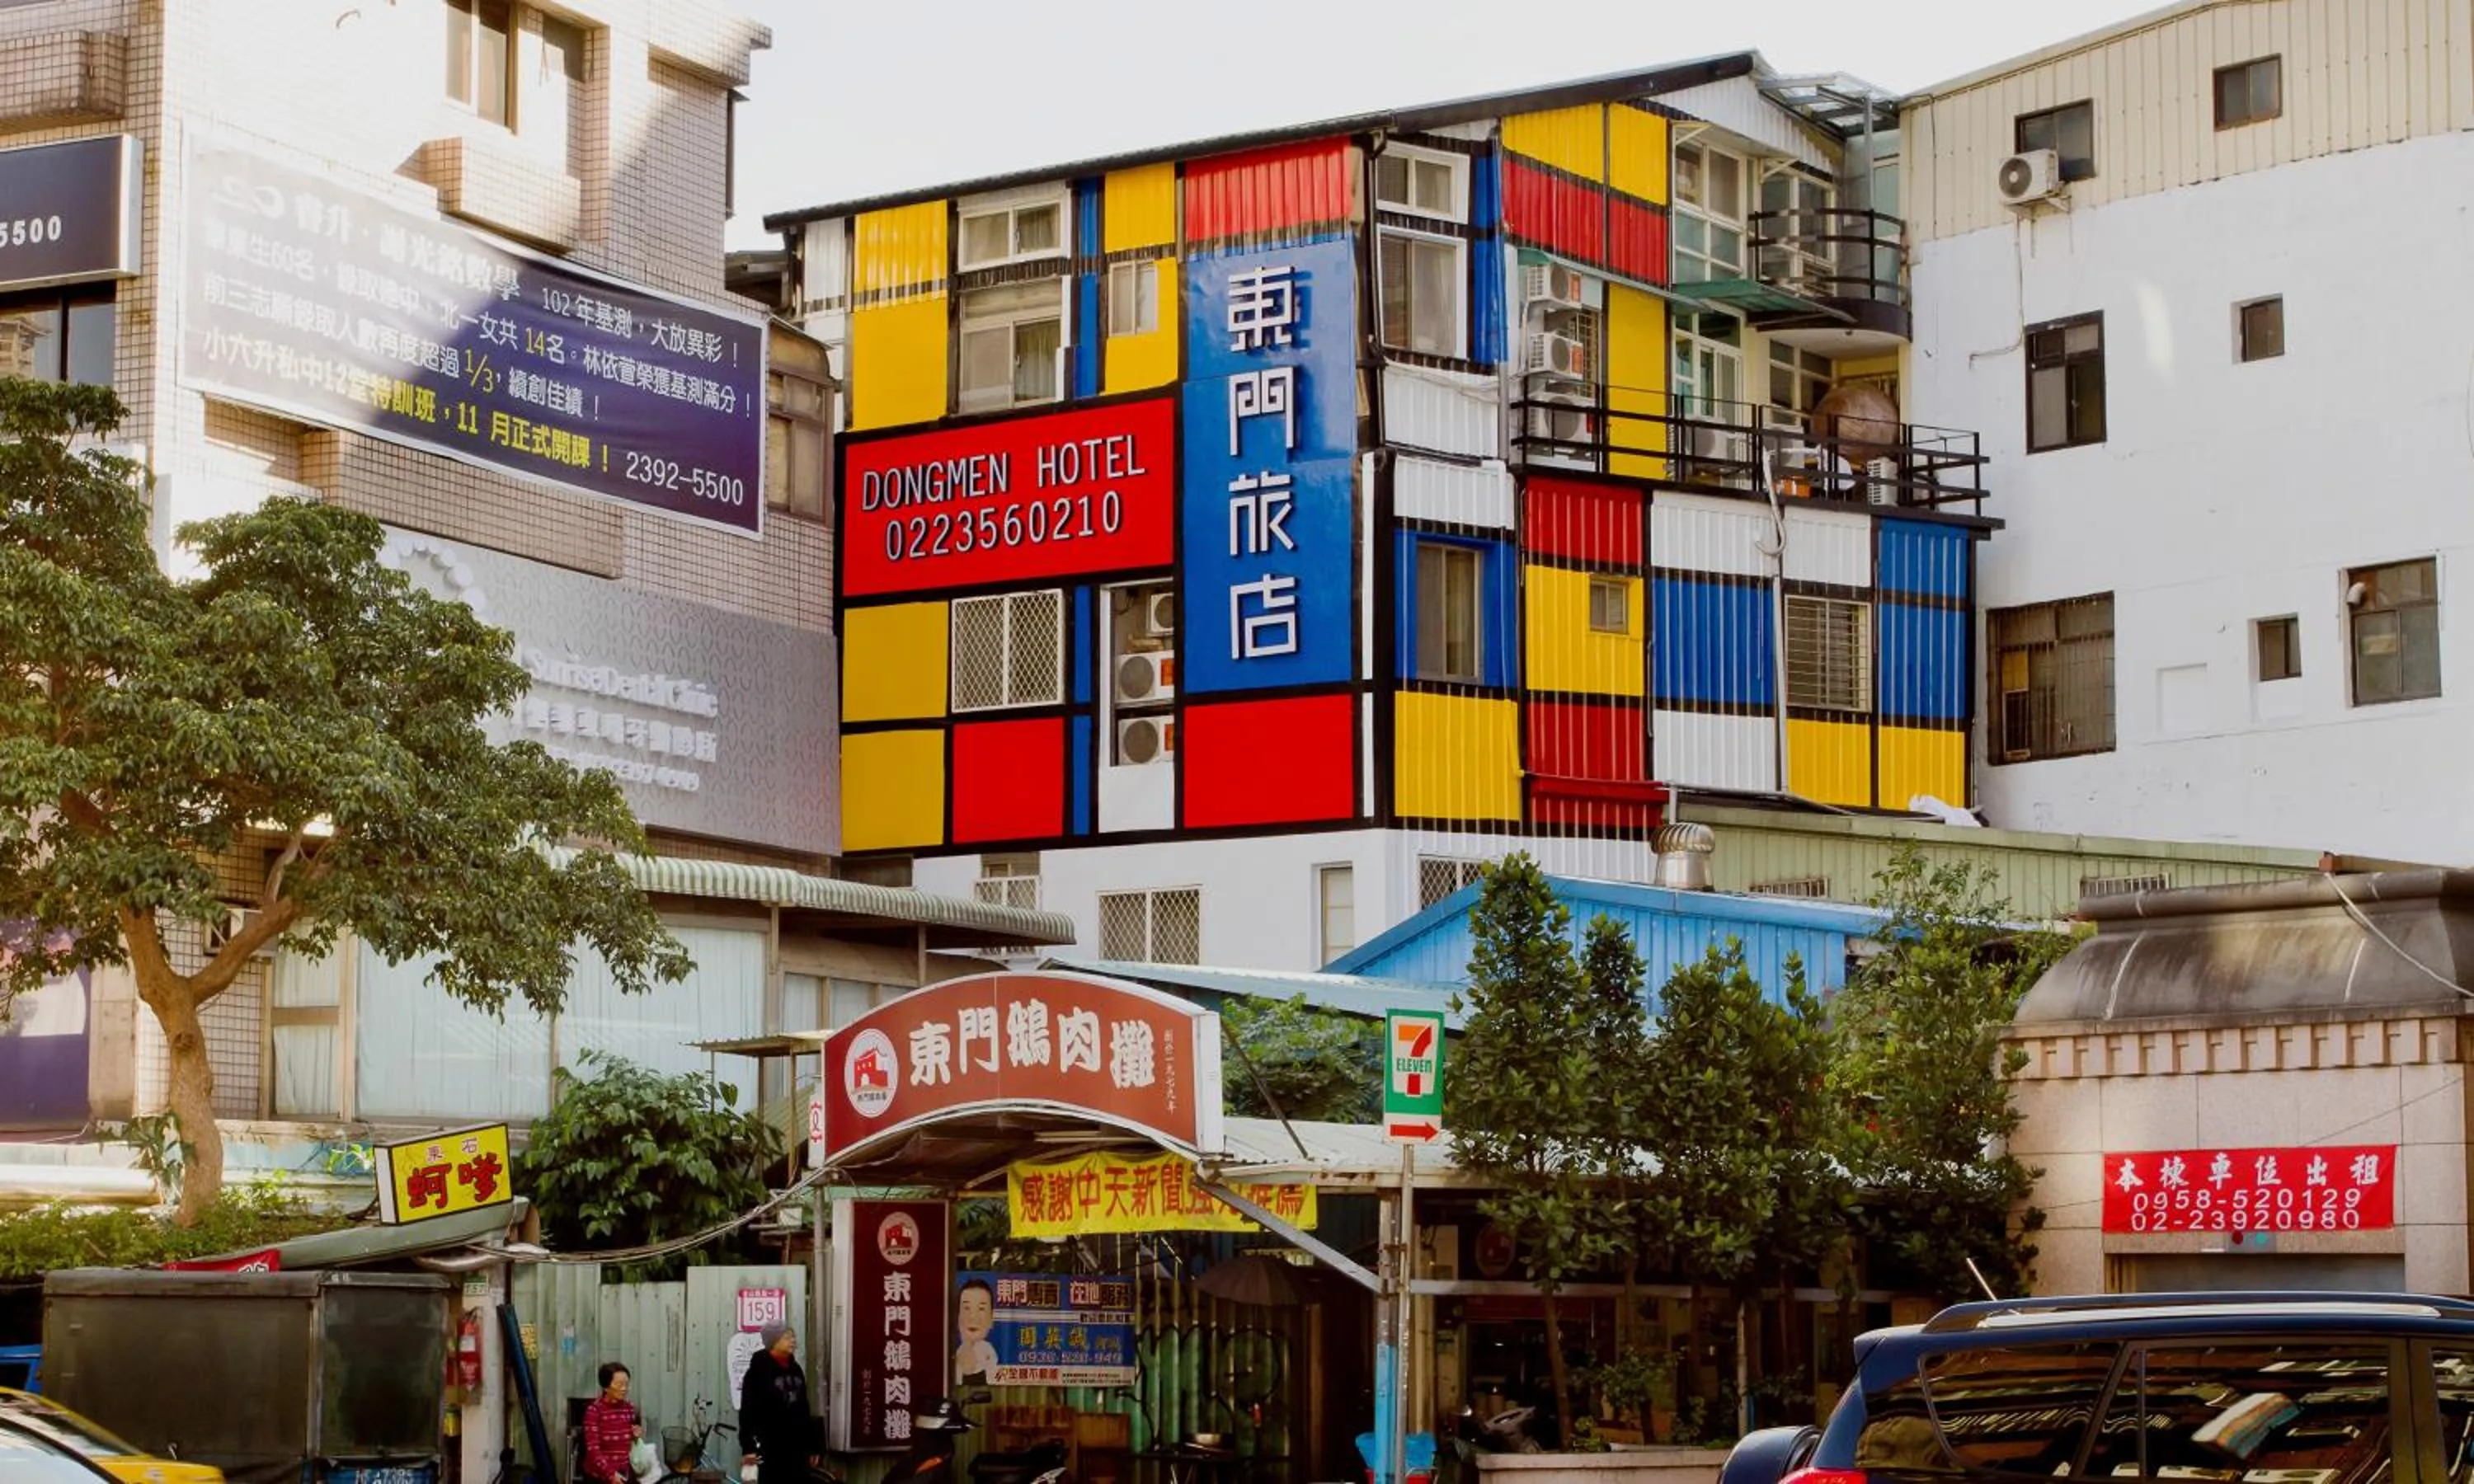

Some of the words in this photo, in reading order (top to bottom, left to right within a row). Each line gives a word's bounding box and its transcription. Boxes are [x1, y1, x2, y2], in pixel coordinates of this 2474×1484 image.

[625, 452, 744, 506] 2392-5500
[862, 451, 1009, 511] DONGMEN
[1037, 434, 1146, 488] HOTEL
[1227, 265, 1298, 660] 東門旅店
[886, 490, 1122, 561] 0223560210
[909, 998, 1155, 1089] 東門鵝肉攤
[2114, 1152, 2379, 1192] 本棟車位出租
[2133, 1187, 2362, 1213] 0958-520129
[2130, 1209, 2361, 1232] 02-23920980
[746, 1301, 776, 1322] 159
[882, 1270, 912, 1440] 東門鵝肉攤
